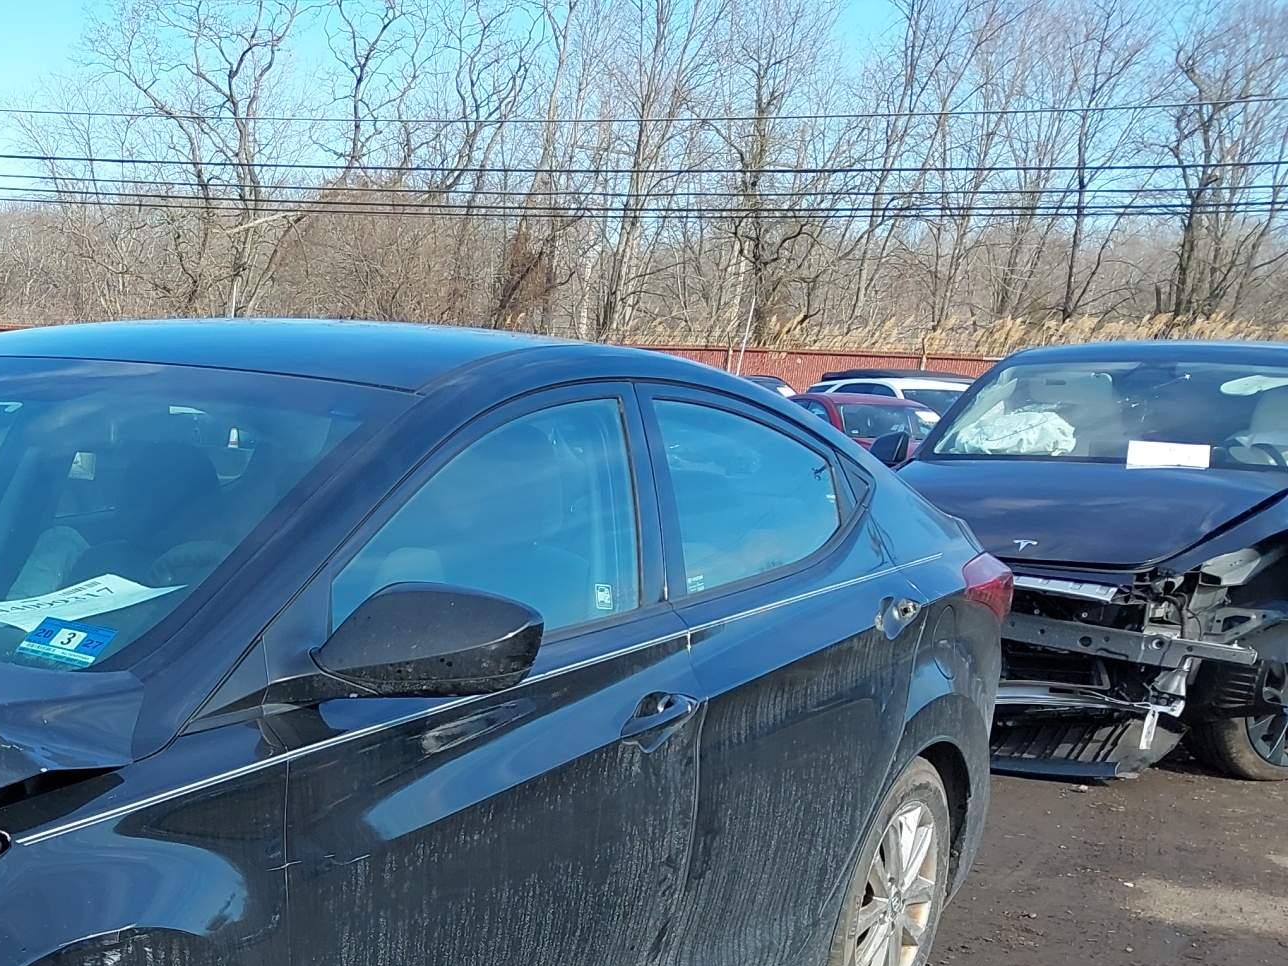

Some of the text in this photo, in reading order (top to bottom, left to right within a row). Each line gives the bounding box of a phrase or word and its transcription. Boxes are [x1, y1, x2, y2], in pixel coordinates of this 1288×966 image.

[35, 628, 104, 649] 20 3 27
